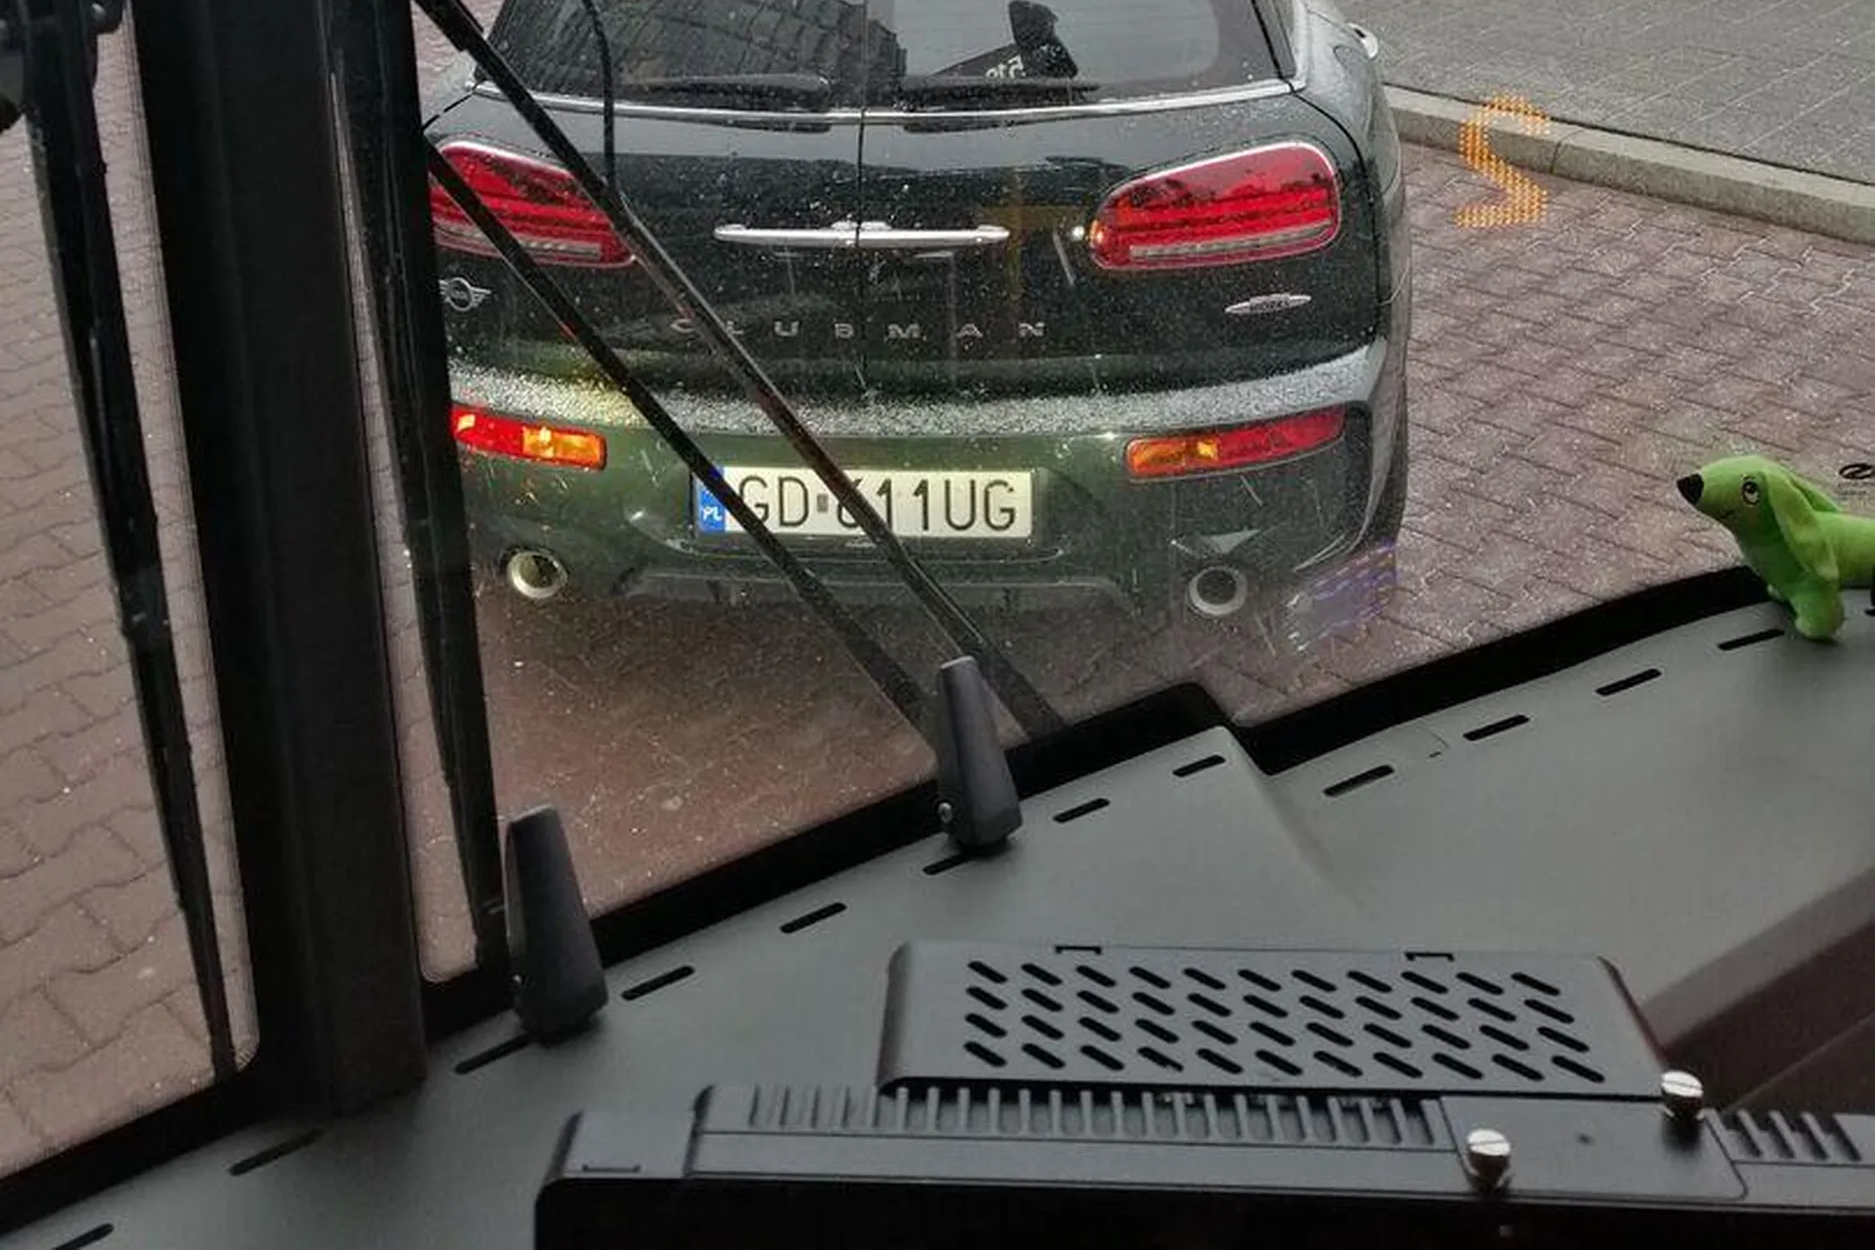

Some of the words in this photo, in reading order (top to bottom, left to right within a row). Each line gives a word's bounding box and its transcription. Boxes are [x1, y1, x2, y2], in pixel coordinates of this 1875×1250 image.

[669, 317, 1046, 340] CLUBMAN
[703, 505, 722, 521] PL
[738, 475, 809, 529] GD
